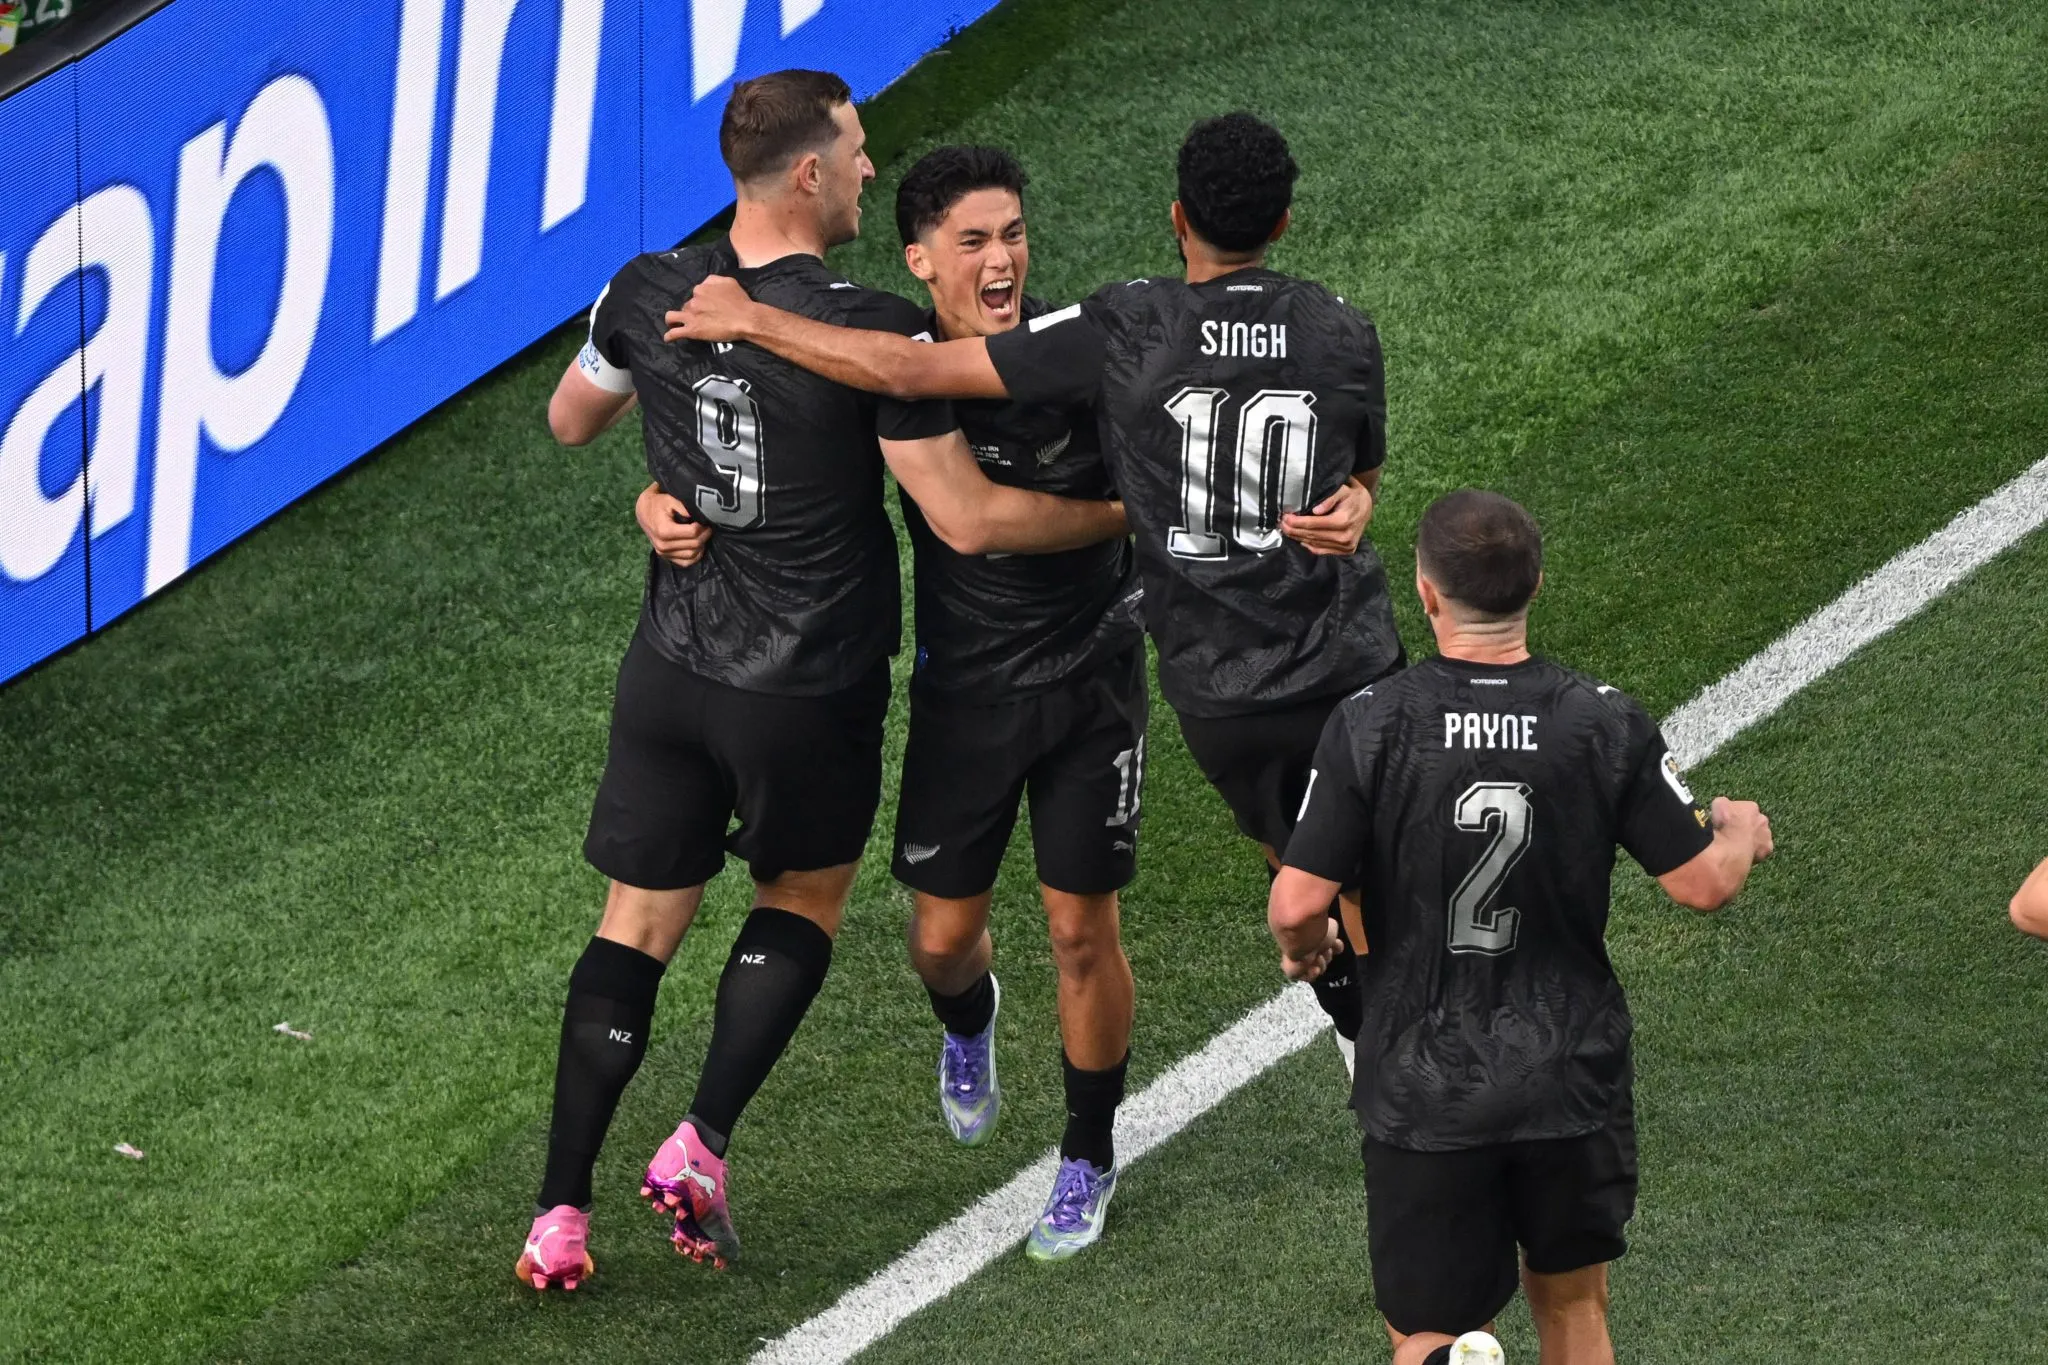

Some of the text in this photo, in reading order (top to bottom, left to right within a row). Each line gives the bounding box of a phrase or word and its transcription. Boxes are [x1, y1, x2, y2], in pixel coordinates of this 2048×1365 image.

[0, 73, 335, 598] ap
[1200, 320, 1287, 359] SINGH
[692, 373, 766, 530] 9
[1163, 386, 1318, 562] 10
[1444, 712, 1538, 751] PAYNE
[1447, 781, 1534, 956] 2
[740, 954, 767, 965] NZ
[608, 1028, 633, 1044] NZ
